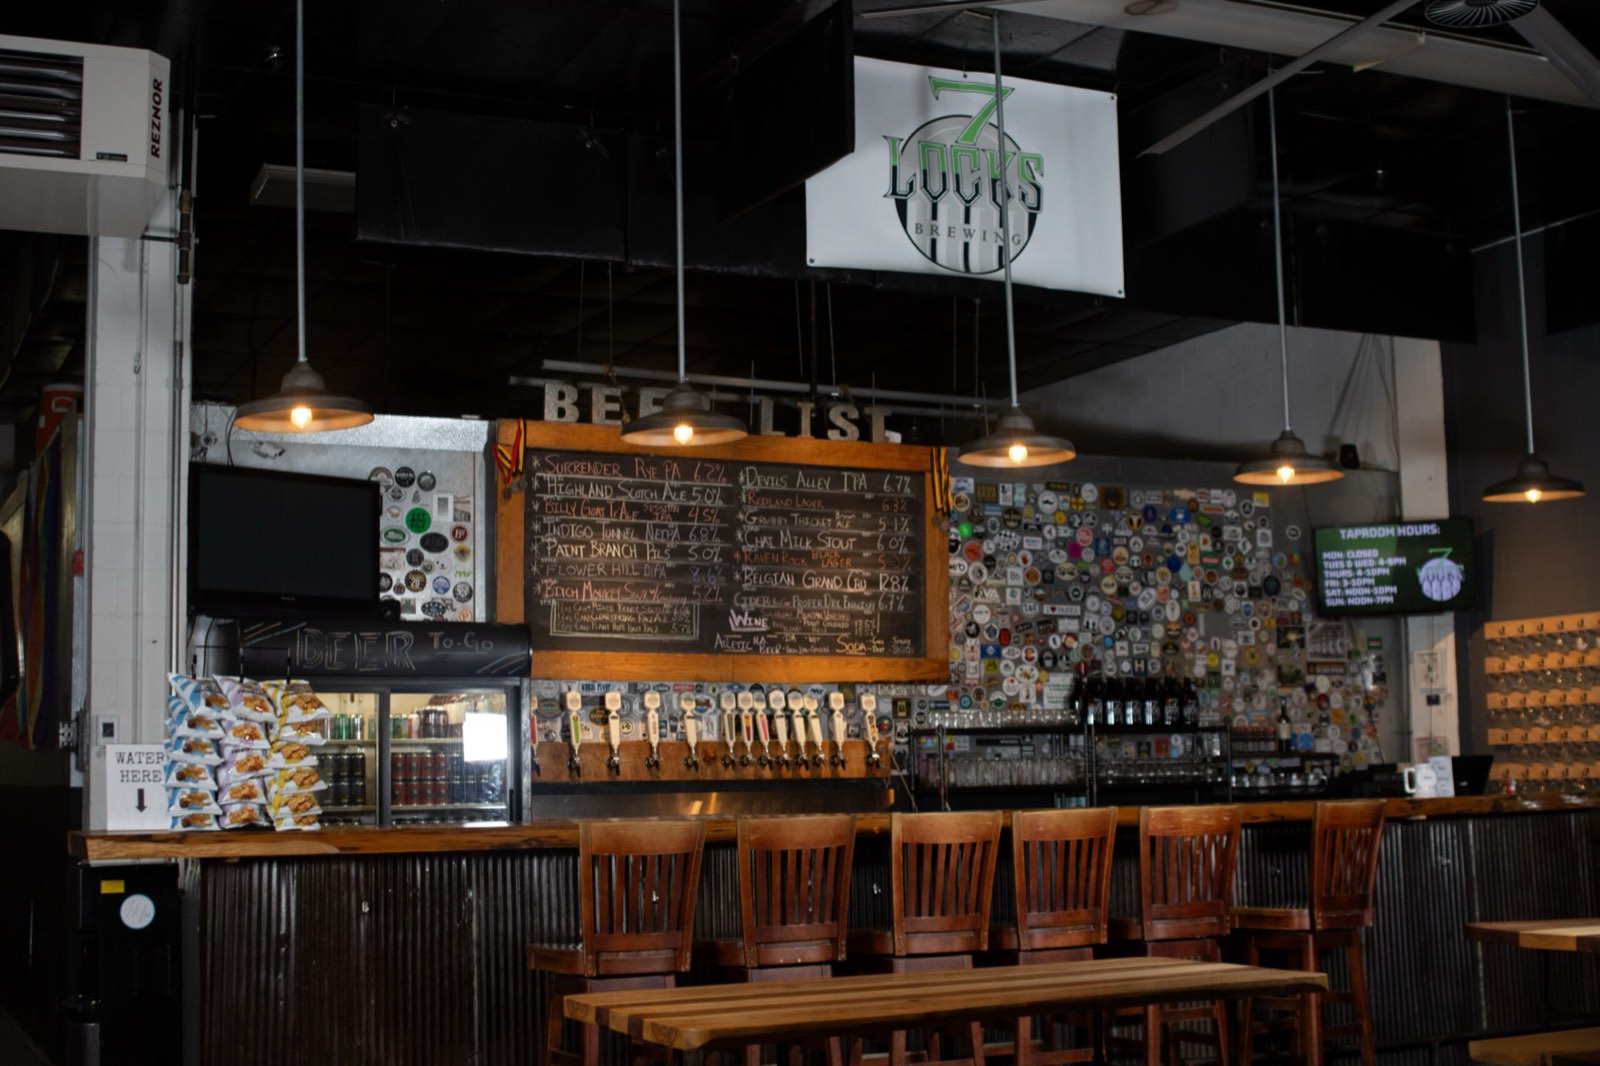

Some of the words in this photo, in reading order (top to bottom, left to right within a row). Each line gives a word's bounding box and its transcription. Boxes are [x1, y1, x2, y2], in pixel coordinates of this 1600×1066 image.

[151, 78, 163, 158] REZNOR
[929, 76, 1015, 145] 7
[882, 135, 1044, 213] LOCKS
[914, 222, 1021, 246] BREWING
[760, 398, 892, 443] LIST
[544, 454, 622, 477] SURRENDER
[664, 461, 681, 480] PA
[547, 477, 614, 499] HIGHLAND
[618, 480, 658, 501] SCOTCH
[662, 484, 687, 501] ALE
[746, 466, 788, 488] DEVILS
[796, 470, 830, 490] ALLEY
[841, 472, 868, 492] IPA
[544, 499, 576, 517] BILLY
[780, 530, 812, 550] MILK
[817, 531, 857, 550] STOUT
[1339, 528, 1395, 539] TAPROOM
[543, 540, 586, 558] PAINT
[590, 540, 638, 559] BRANCH
[1346, 549, 1378, 558] CLOSED
[545, 563, 608, 577] FLOWER
[611, 563, 639, 576] HILL
[744, 568, 795, 587] BELGIAN
[802, 569, 843, 589] GRAND
[730, 608, 768, 627] WINE
[296, 627, 415, 671] BEER
[835, 633, 867, 653] SODA
[115, 751, 168, 765] WATER
[119, 769, 163, 783] HERE
